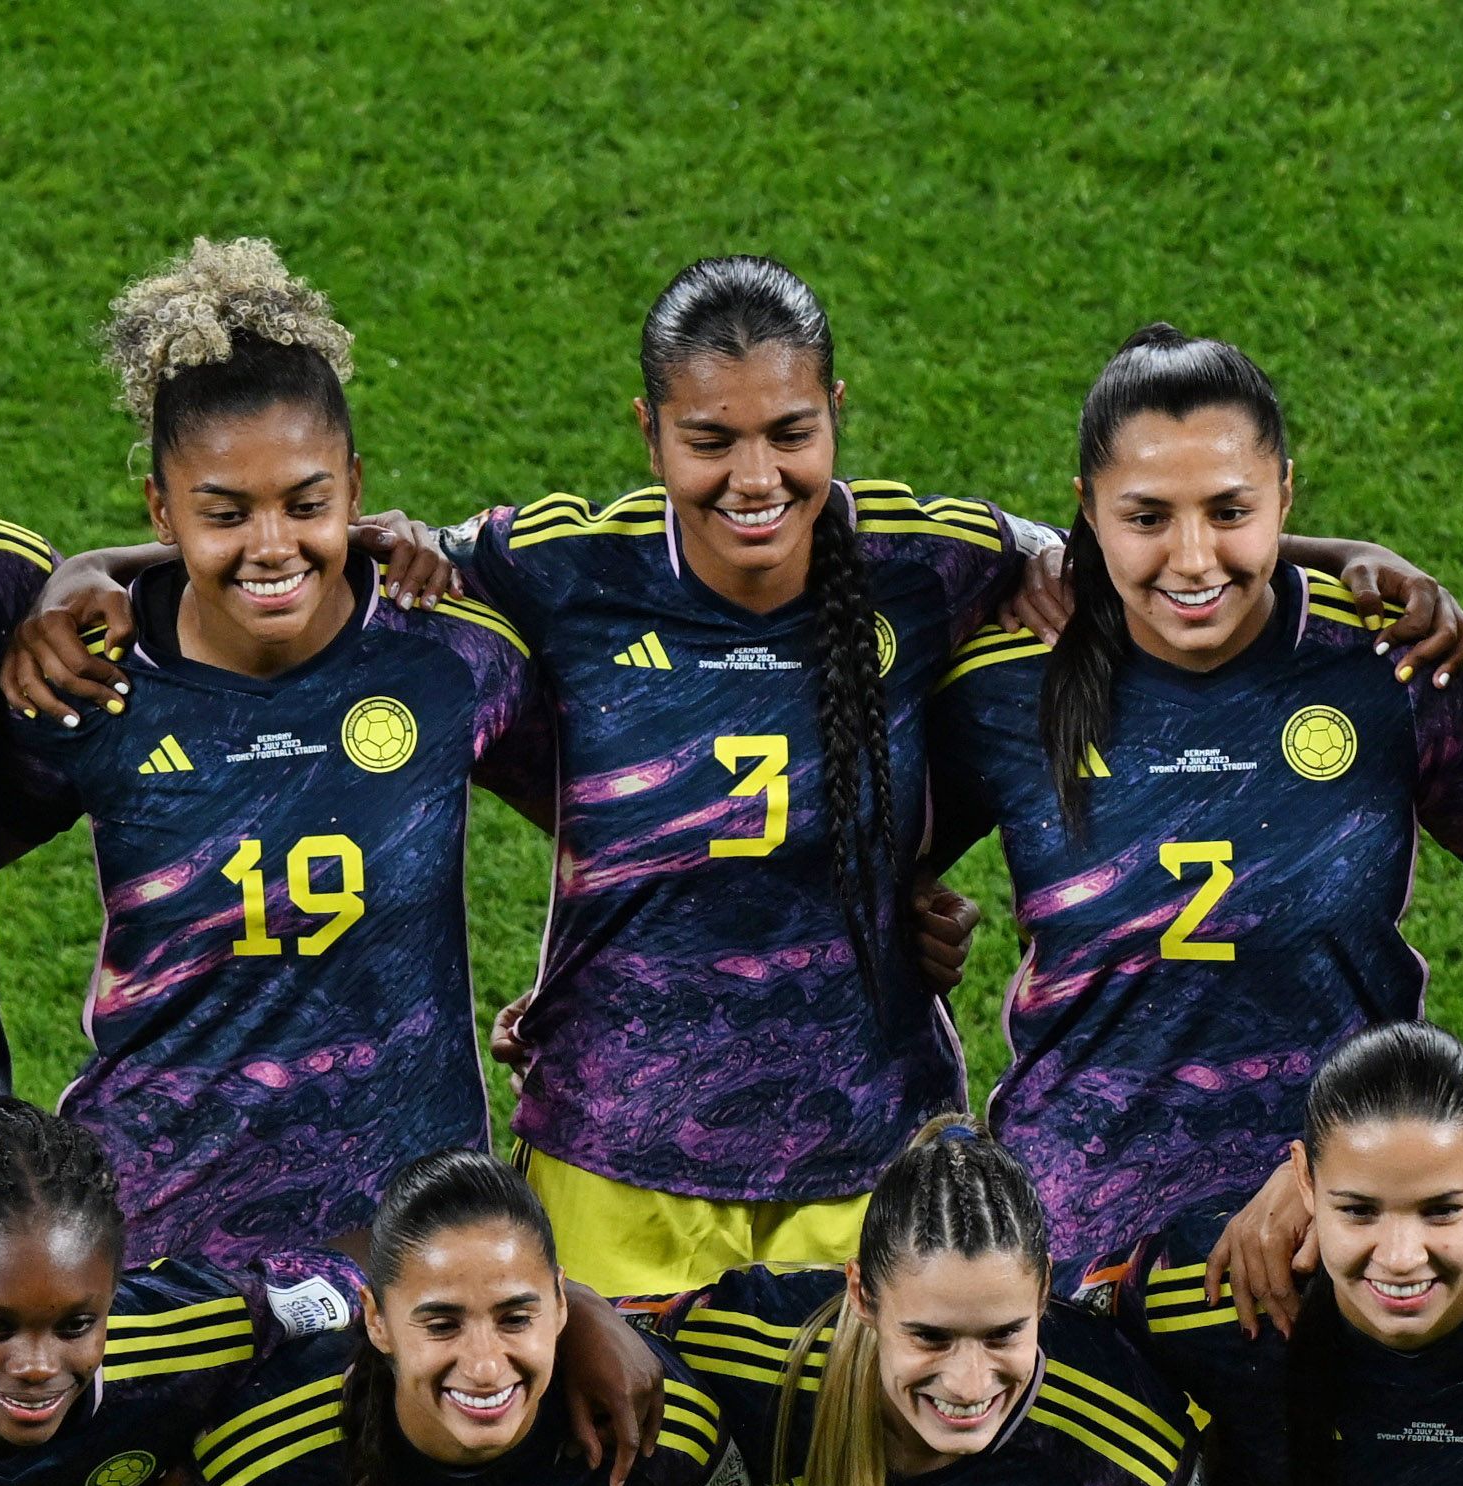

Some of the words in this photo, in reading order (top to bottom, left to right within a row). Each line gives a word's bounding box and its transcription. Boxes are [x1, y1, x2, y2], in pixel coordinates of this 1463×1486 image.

[757, 654, 776, 662] 2023
[699, 660, 728, 669] SYDNEY
[730, 662, 767, 670] FOOTBALL
[257, 732, 292, 743] GERMANY
[250, 744, 260, 752] 30
[262, 742, 280, 751] JULY
[282, 739, 301, 748] 2023
[226, 752, 255, 763] SYDNEY
[257, 749, 293, 759] FOOTBALL
[295, 745, 327, 755] STADIUM
[1184, 749, 1220, 757] GERMANY
[1177, 757, 1186, 765] 30
[1189, 757, 1207, 765] JULY
[1209, 756, 1229, 764] 2023
[1149, 765, 1180, 773] SYDNEY
[1181, 763, 1221, 772] FOOTBALL
[1222, 762, 1257, 771] STADIUM
[710, 735, 789, 857] 3
[221, 834, 365, 956] 19
[1159, 841, 1235, 960] 2
[1377, 1433, 1405, 1441] SYDNEY
[1407, 1434, 1444, 1442] FOOTBALL
